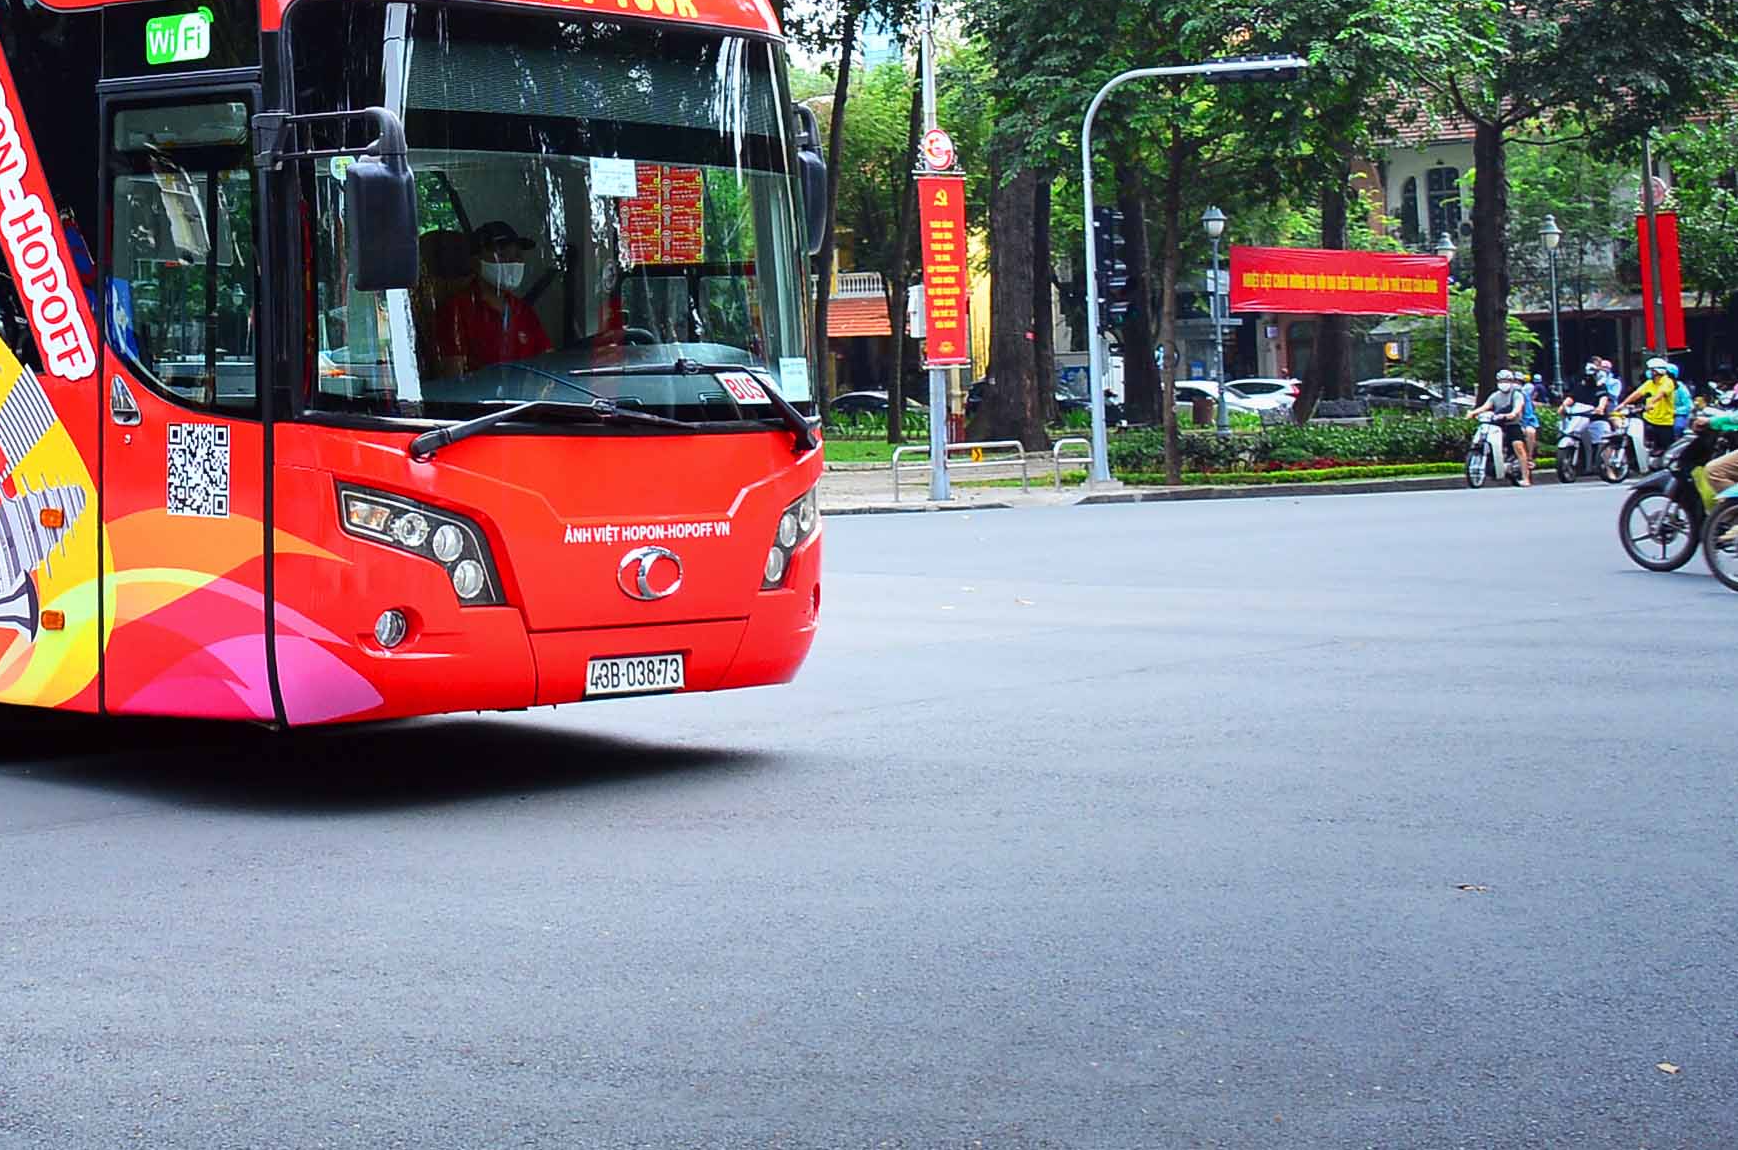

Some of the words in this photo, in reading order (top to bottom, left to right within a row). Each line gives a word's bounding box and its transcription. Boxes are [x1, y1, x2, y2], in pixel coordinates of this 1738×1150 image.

[725, 377, 766, 400] BUS
[593, 523, 620, 546] VIỆT
[622, 521, 713, 541] HOPON-HOPOFF
[714, 521, 730, 536] VN
